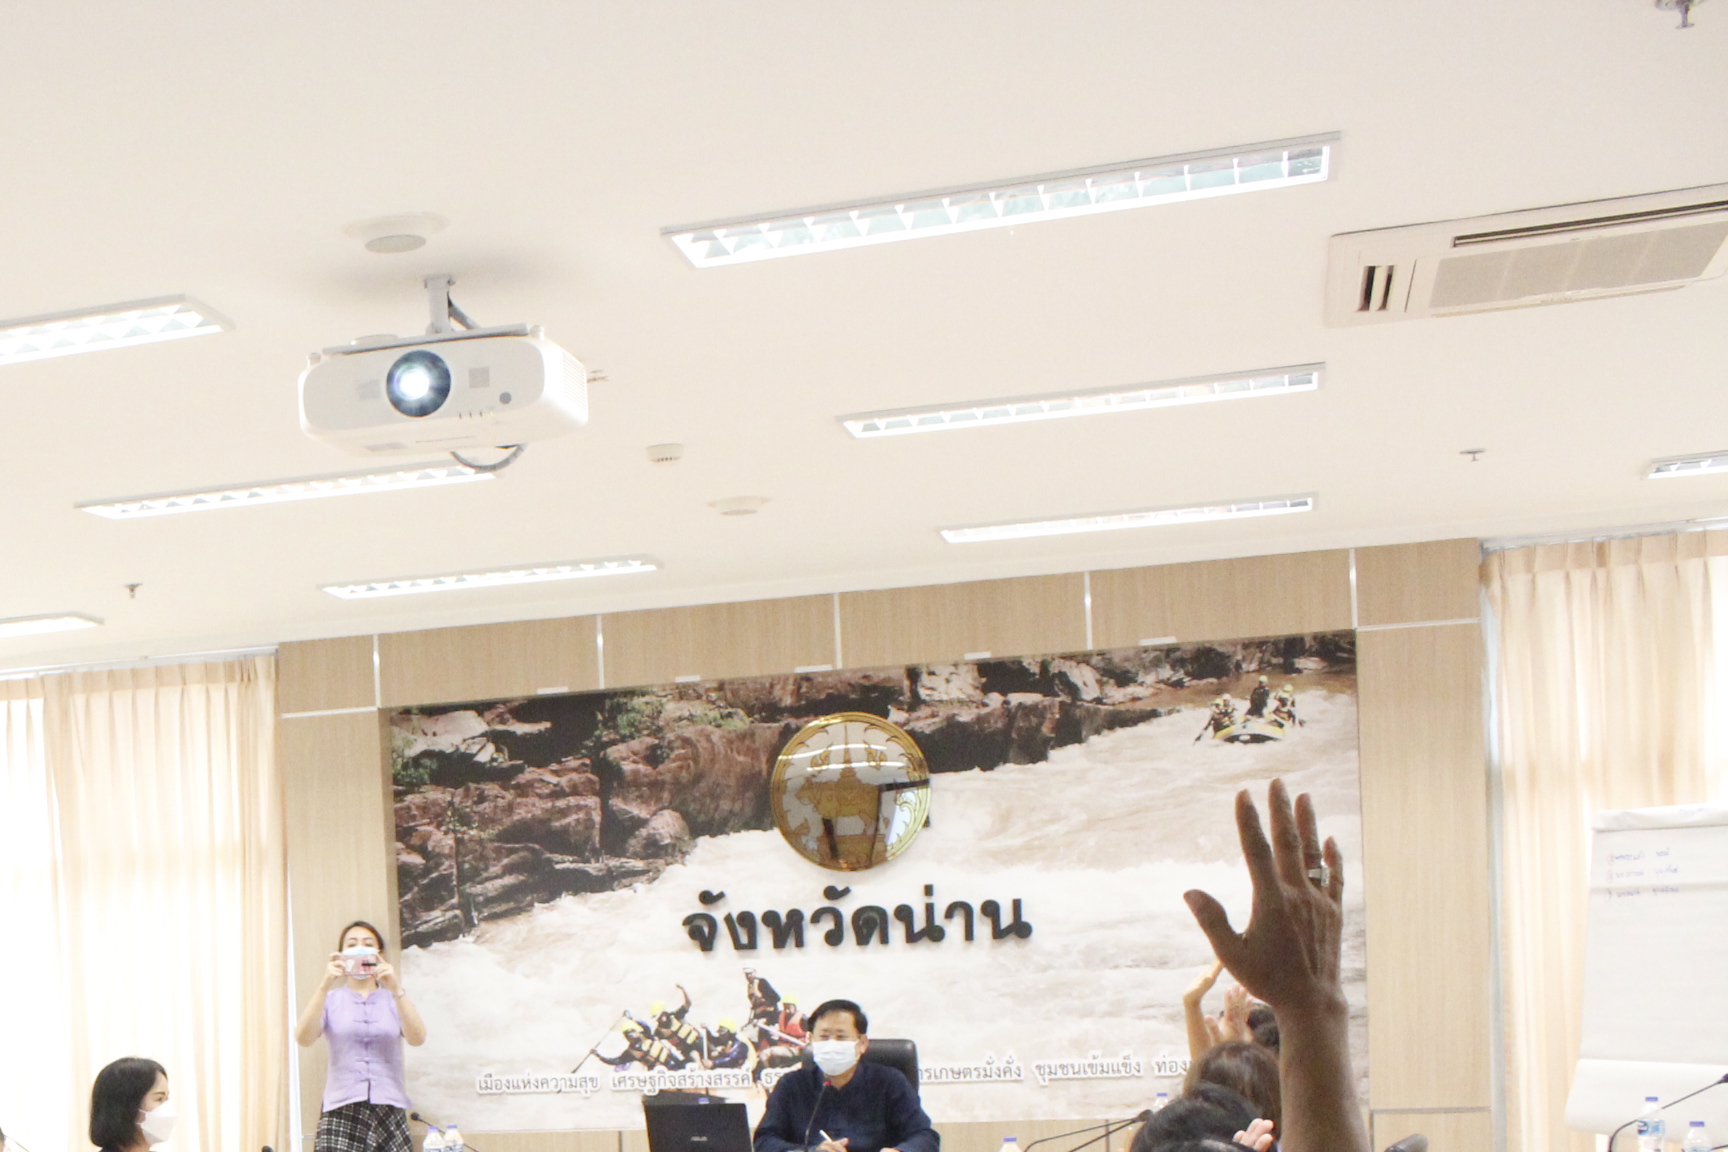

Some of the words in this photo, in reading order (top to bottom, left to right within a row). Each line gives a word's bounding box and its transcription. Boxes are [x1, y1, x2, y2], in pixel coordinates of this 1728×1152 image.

[682, 884, 1033, 951] จังหวัดน่าน
[478, 1072, 599, 1094] เมืองแห่งความสุข
[612, 1066, 751, 1093] เศรษฐกิจสร้างสรรค์
[917, 1055, 1022, 1081] ารเกษตรมั่งคั่ง
[1035, 1053, 1142, 1082] ชุมชนเข้มแข็ง
[1154, 1054, 1191, 1074] ท่อง
